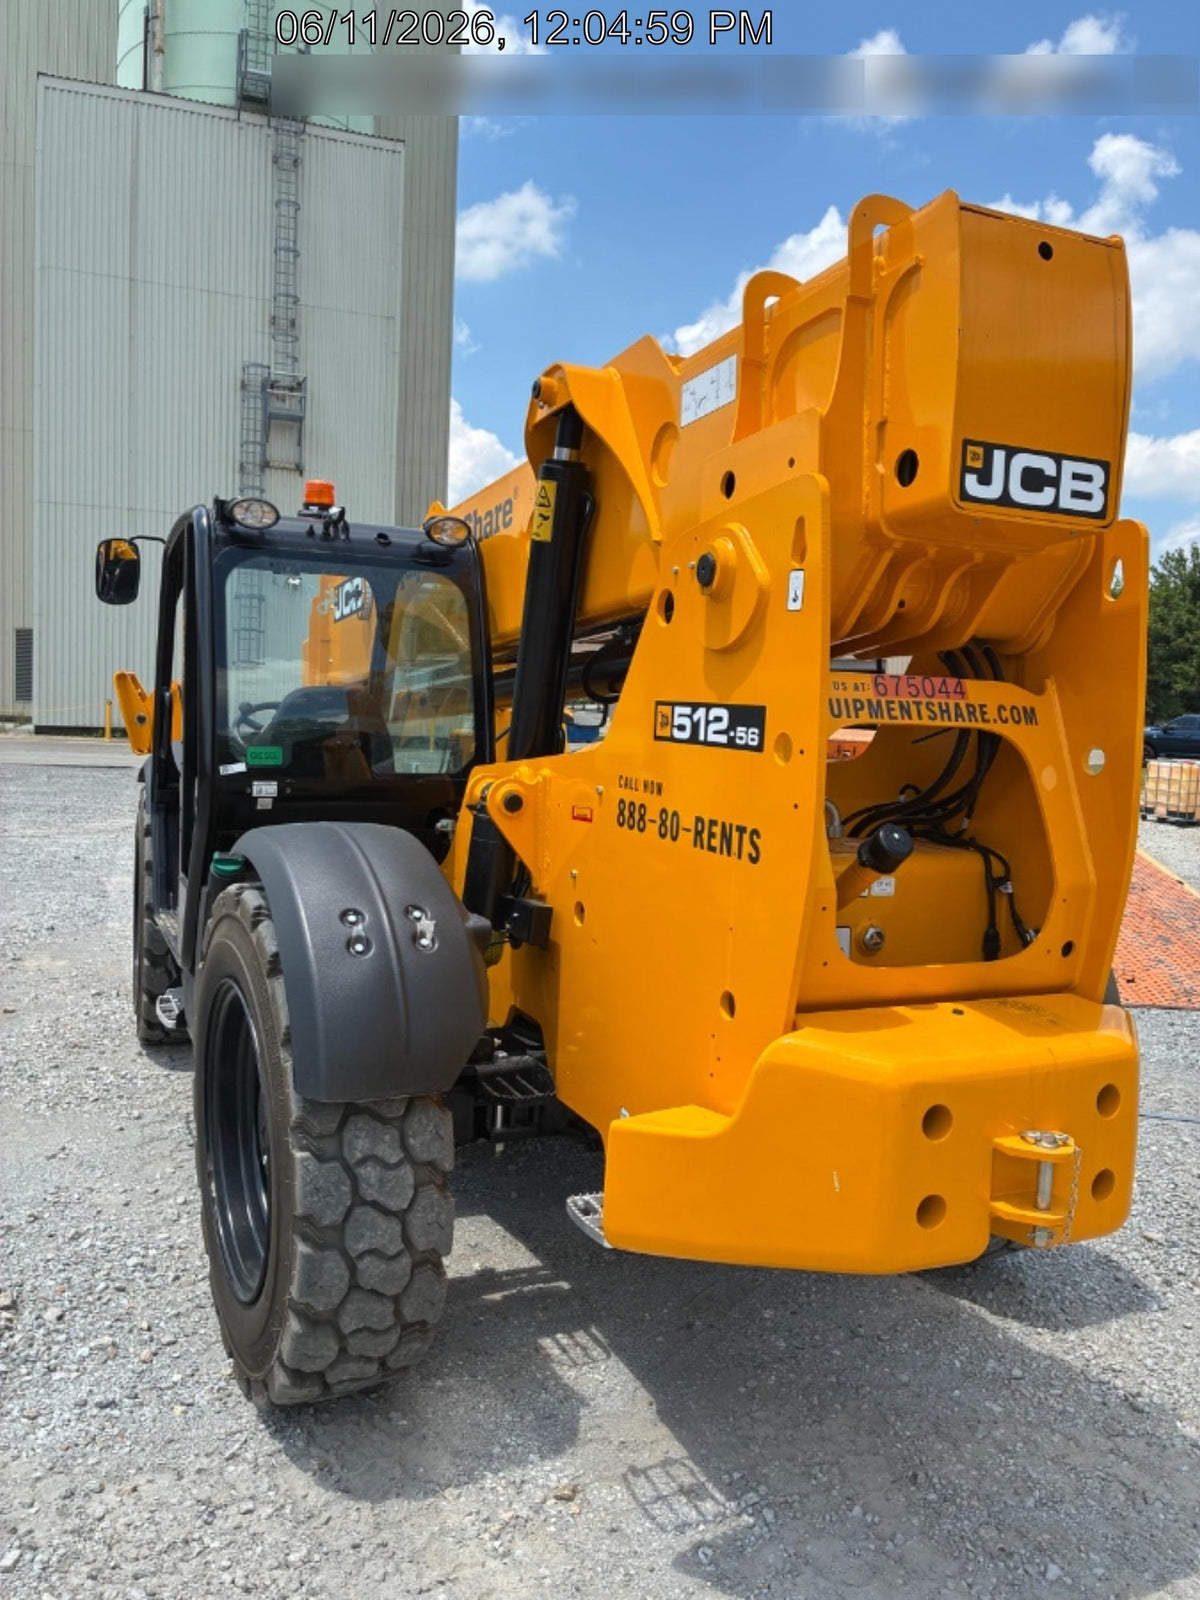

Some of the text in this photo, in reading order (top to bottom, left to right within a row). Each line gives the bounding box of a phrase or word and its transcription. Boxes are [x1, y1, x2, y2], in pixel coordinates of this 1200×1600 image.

[965, 449, 1105, 513] JCB
[874, 675, 966, 699] 675044
[618, 774, 663, 796] CALL NOW
[616, 798, 761, 865] 888-80-RENTS
